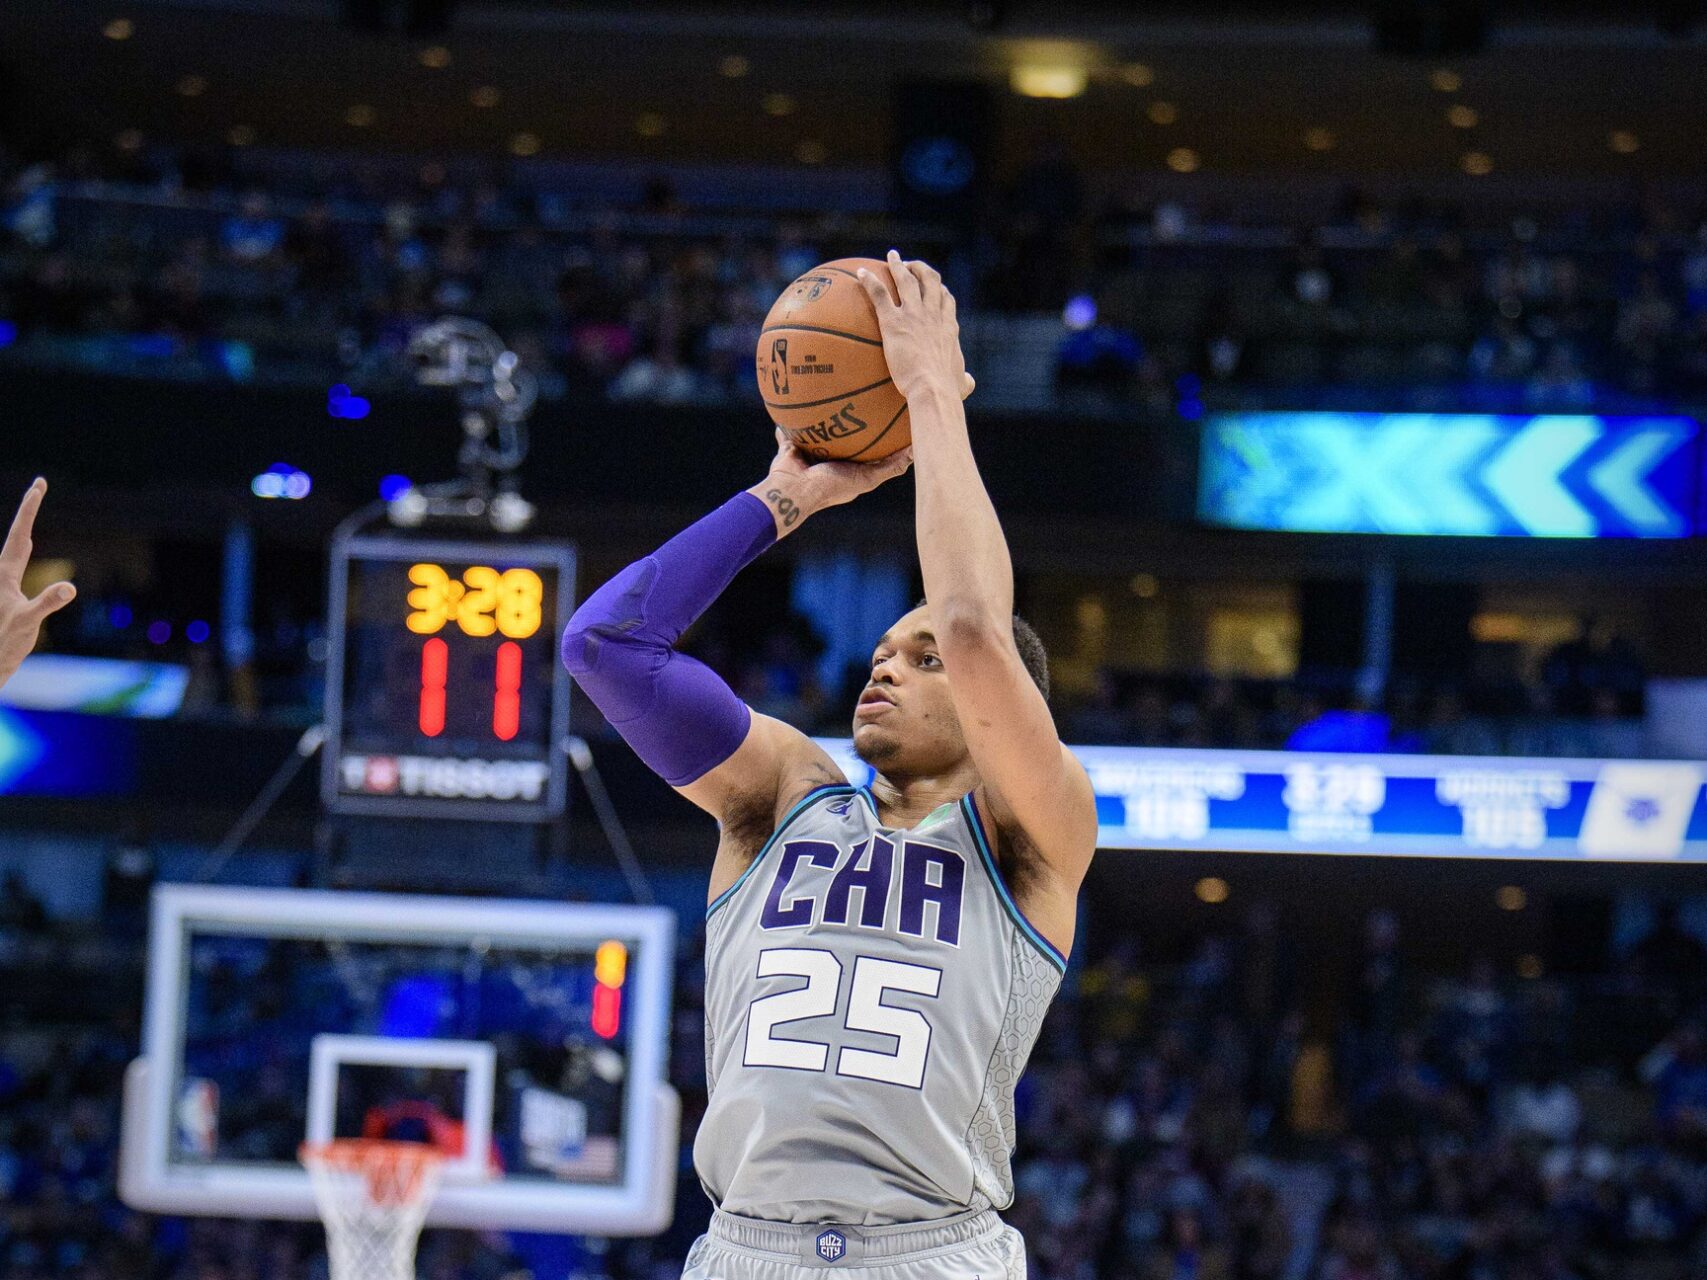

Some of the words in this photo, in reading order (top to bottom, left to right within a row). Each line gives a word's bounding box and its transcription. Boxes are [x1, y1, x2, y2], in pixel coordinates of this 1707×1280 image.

[778, 402, 868, 445] SPAL
[406, 563, 543, 639] 3:28
[419, 637, 523, 741] 11
[403, 756, 549, 801] TISSOT
[759, 833, 967, 949] CHA
[742, 947, 943, 1090] 25
[819, 1233, 842, 1246] BUZZ
[821, 1246, 841, 1259] CITY
